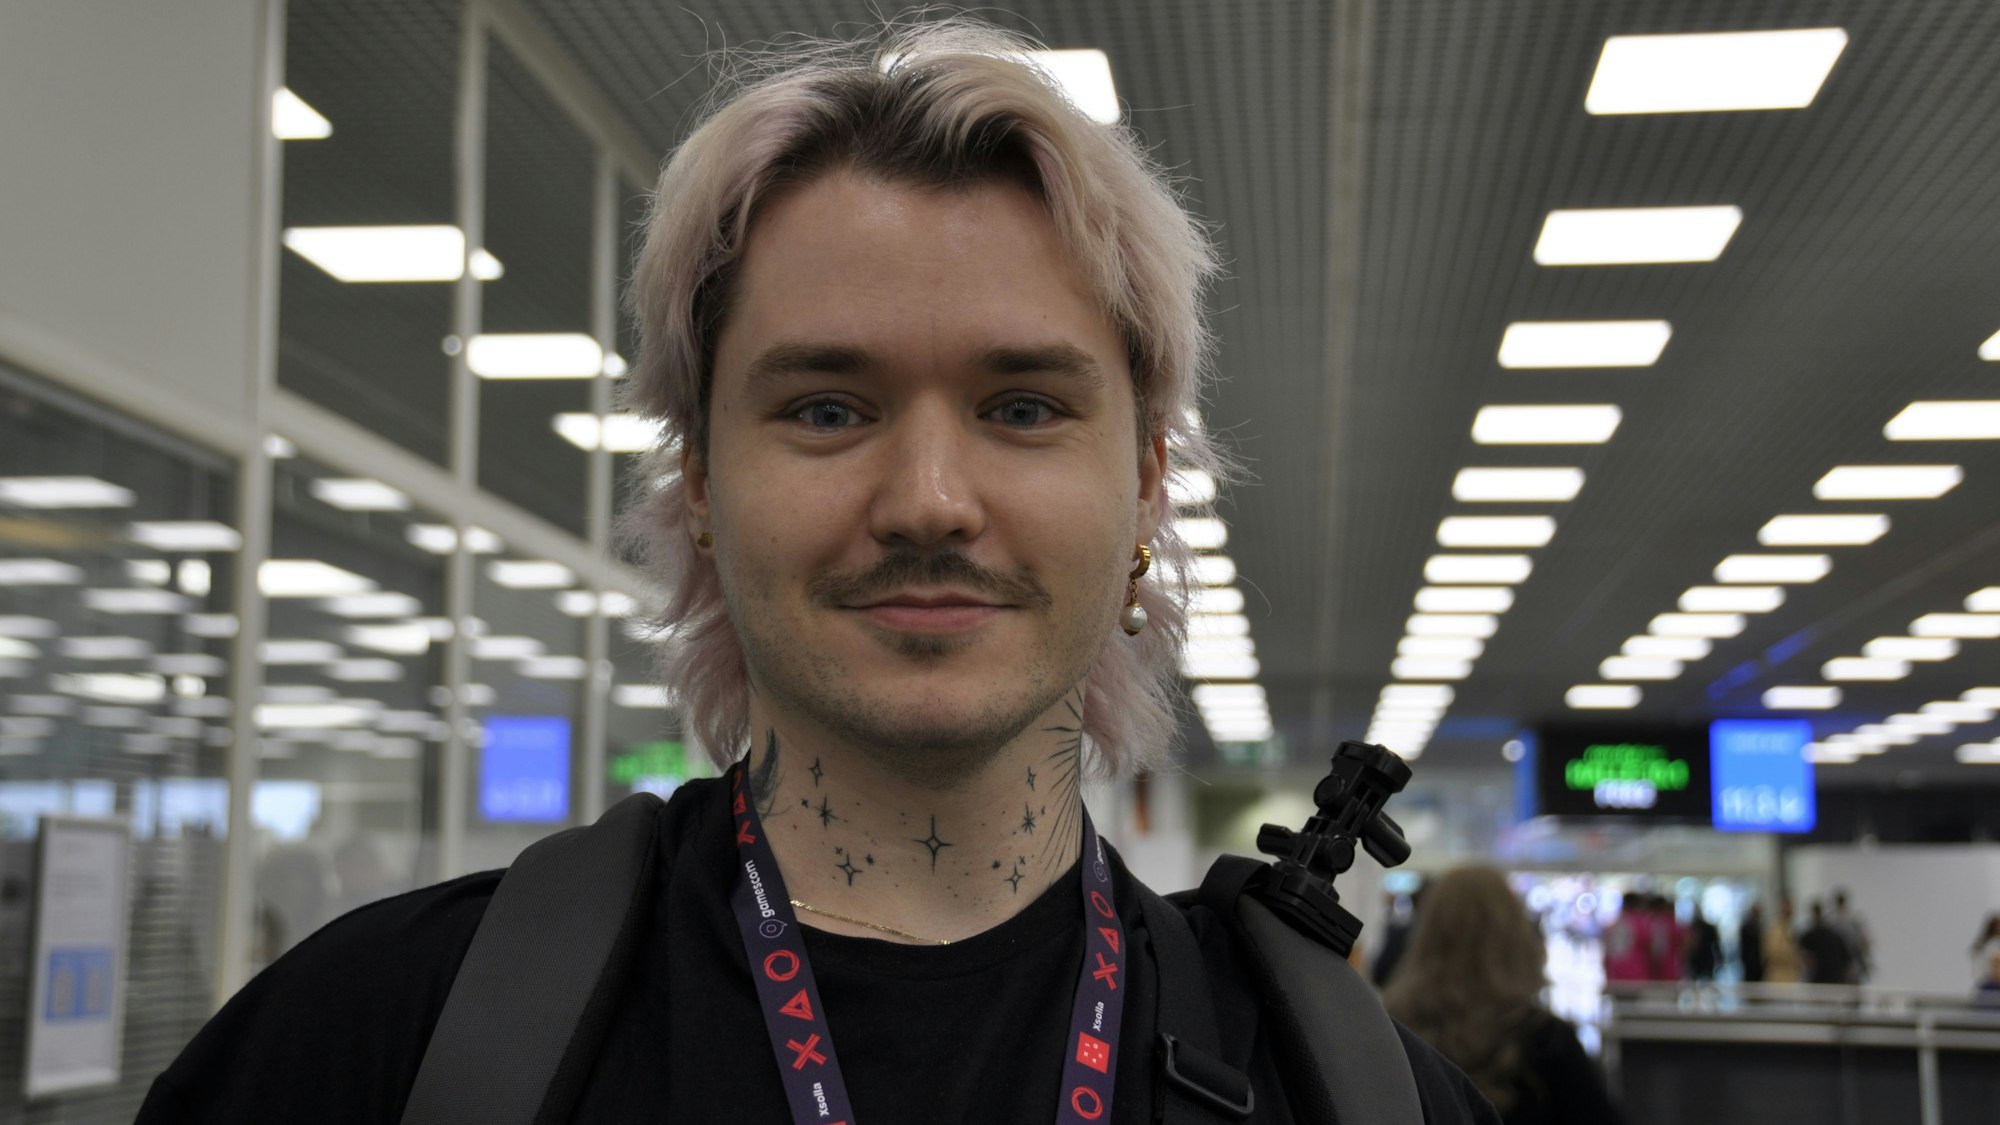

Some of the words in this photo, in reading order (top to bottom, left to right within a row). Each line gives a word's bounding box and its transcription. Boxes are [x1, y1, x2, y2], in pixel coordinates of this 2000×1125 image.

[745, 859, 775, 918] gamescom
[1092, 1001, 1105, 1032] Xsolla
[813, 1082, 830, 1117] Xsolla
